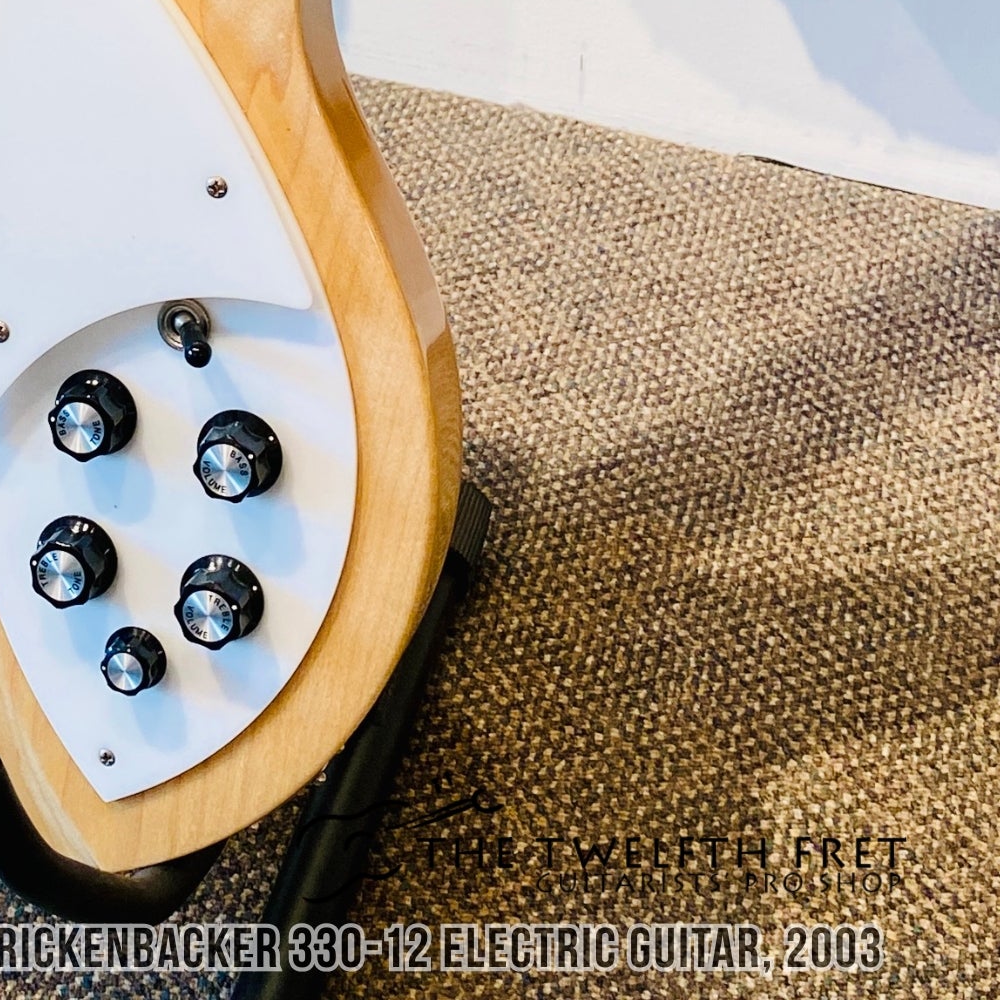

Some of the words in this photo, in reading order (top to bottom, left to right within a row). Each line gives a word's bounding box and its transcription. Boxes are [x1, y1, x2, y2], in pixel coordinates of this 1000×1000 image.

[58, 410, 70, 436] BASS
[90, 420, 102, 445] TONE
[202, 460, 227, 493] VOLUME
[230, 450, 249, 476] BASS
[38, 553, 58, 587] TREBLE
[67, 571, 82, 595] TONE
[185, 605, 208, 639] VOLUME
[209, 594, 231, 631] TREBLE
